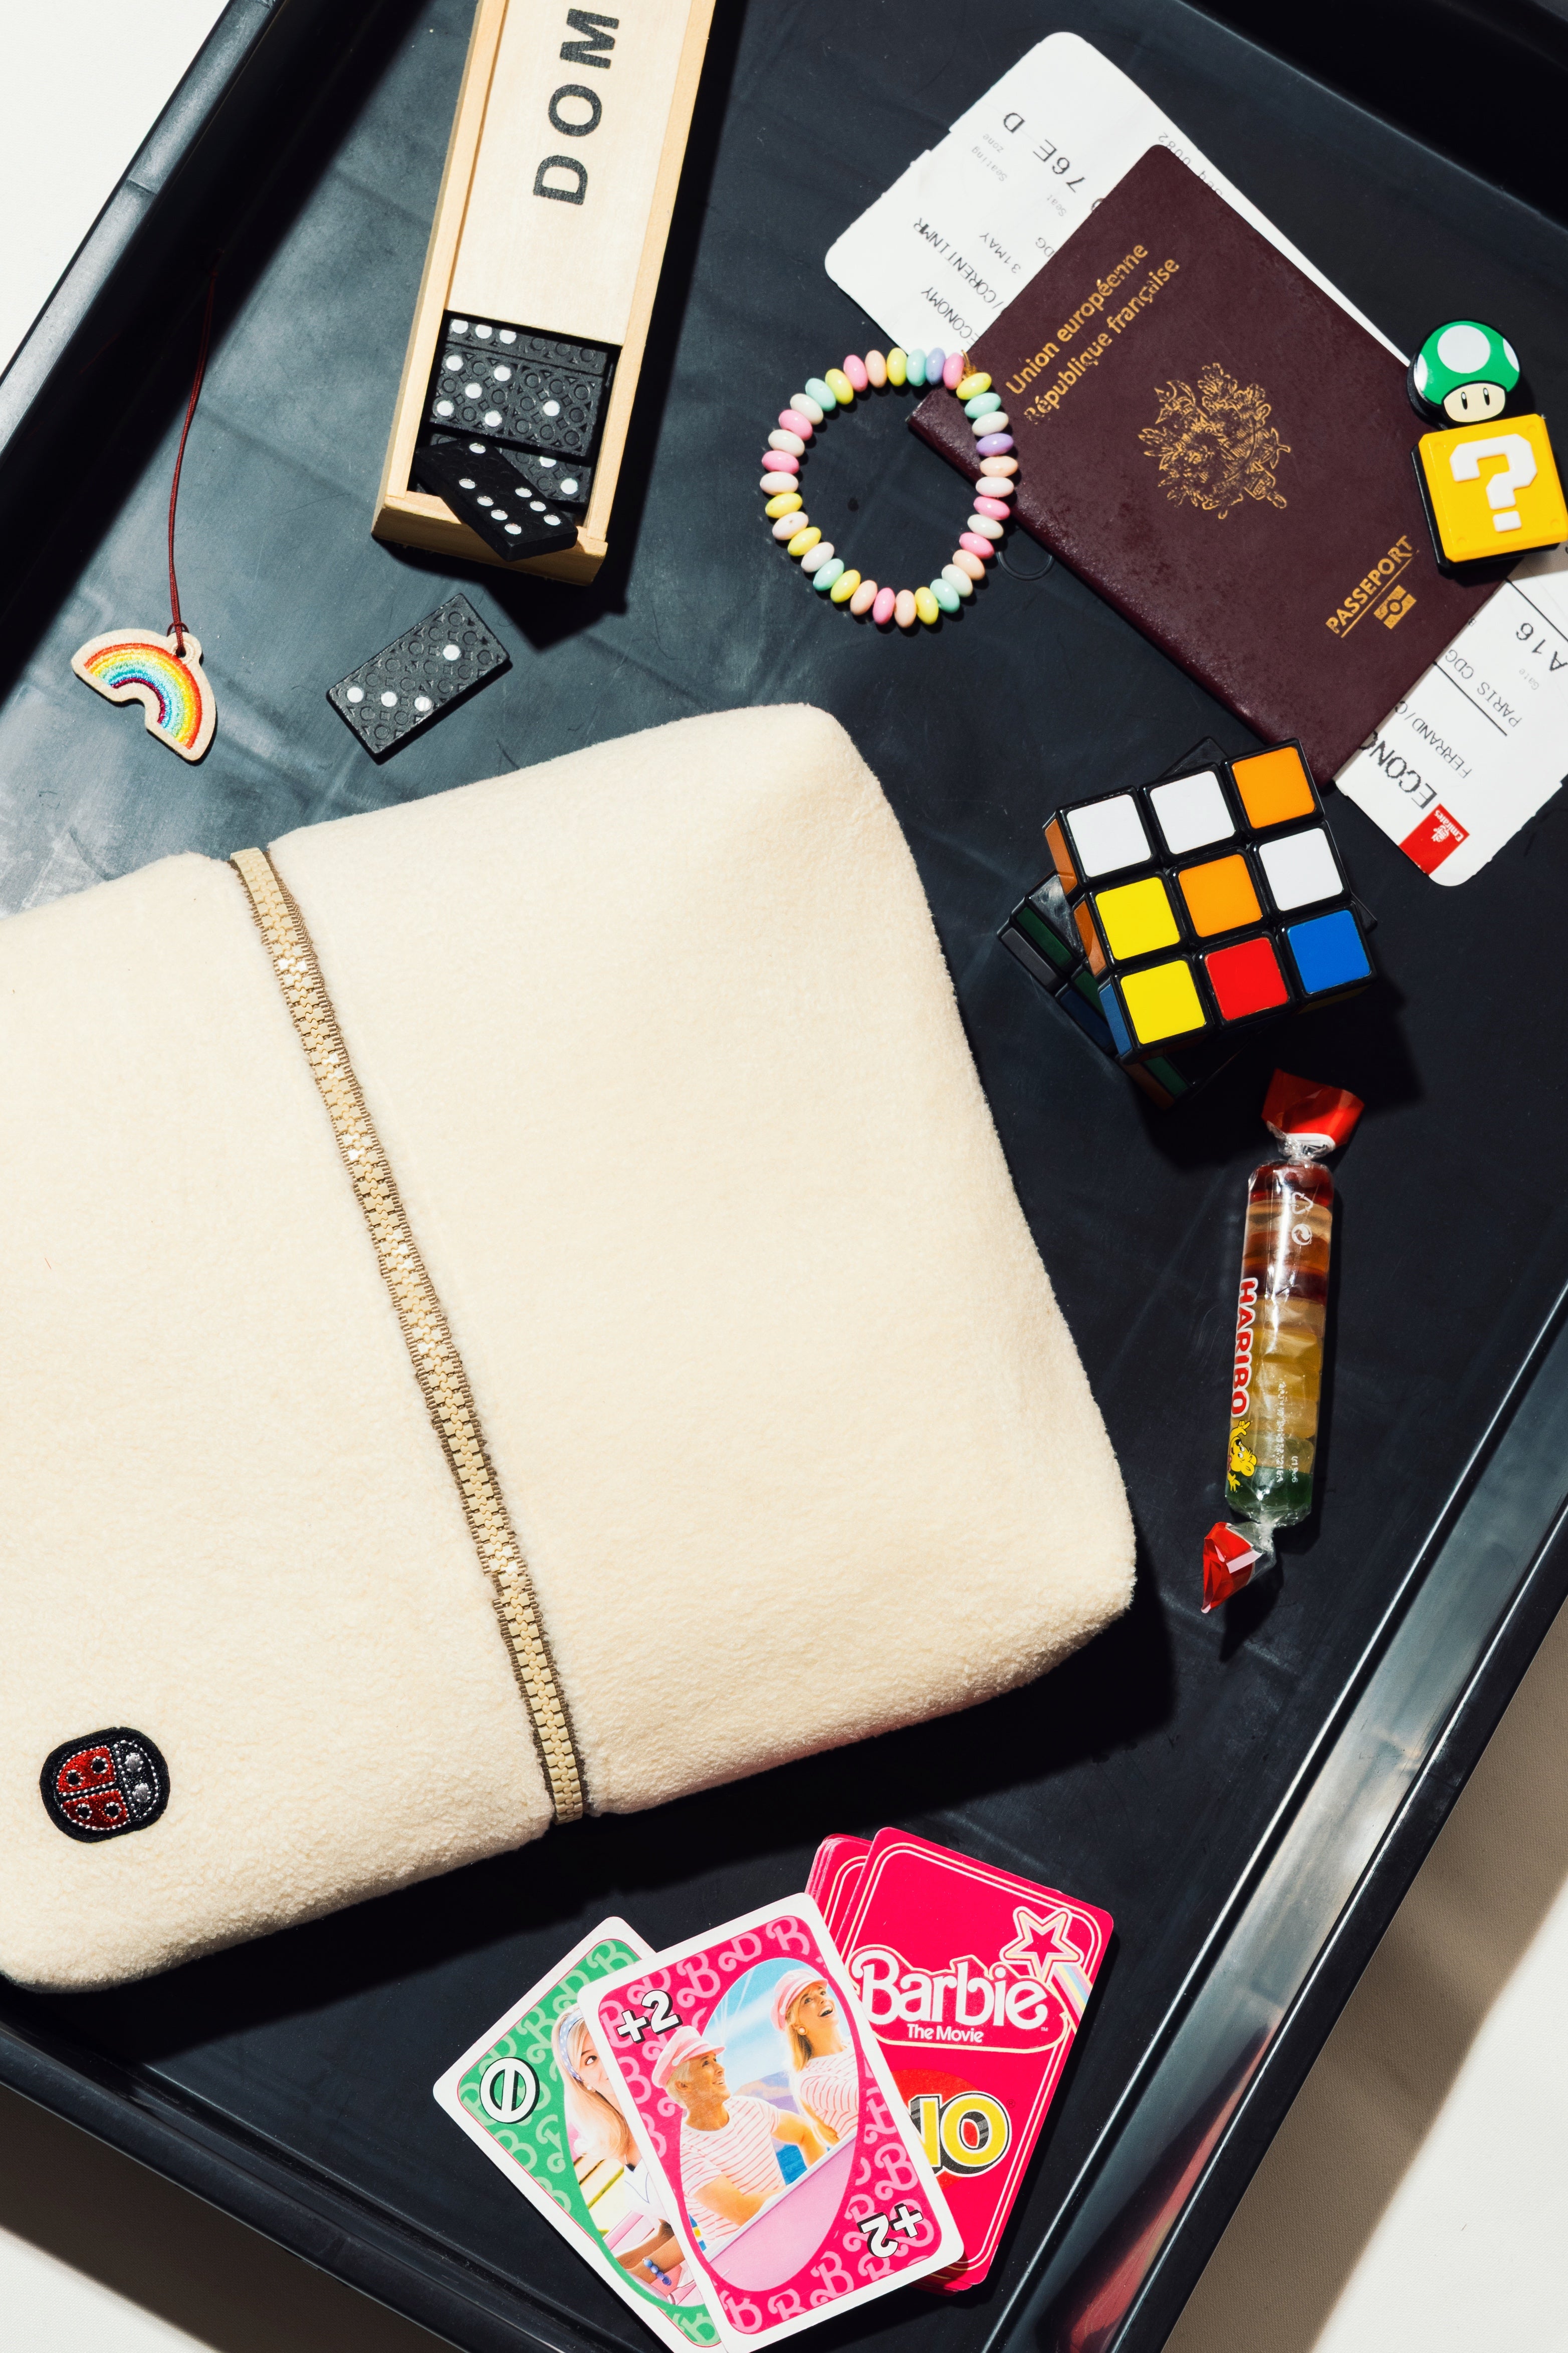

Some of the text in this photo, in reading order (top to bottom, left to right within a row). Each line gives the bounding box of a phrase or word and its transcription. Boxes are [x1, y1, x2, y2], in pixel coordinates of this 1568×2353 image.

[533, 8, 619, 206] DOM
[982, 132, 1004, 153] zone
[971, 144, 1008, 183] Seating
[1003, 111, 1086, 193] 76E D
[1006, 244, 1149, 395] Union européenne
[1106, 258, 1180, 334] française
[1325, 534, 1414, 634] PASSEPORT
[1445, 649, 1522, 727] PARIS CDG
[1434, 808, 1464, 842] Emirates
[1231, 1277, 1258, 1418] HARIBO
[617, 1989, 682, 2044] +2
[851, 1956, 1049, 2030] Barbie
[907, 2023, 984, 2044] The Movie
[857, 2203, 924, 2259] +2
